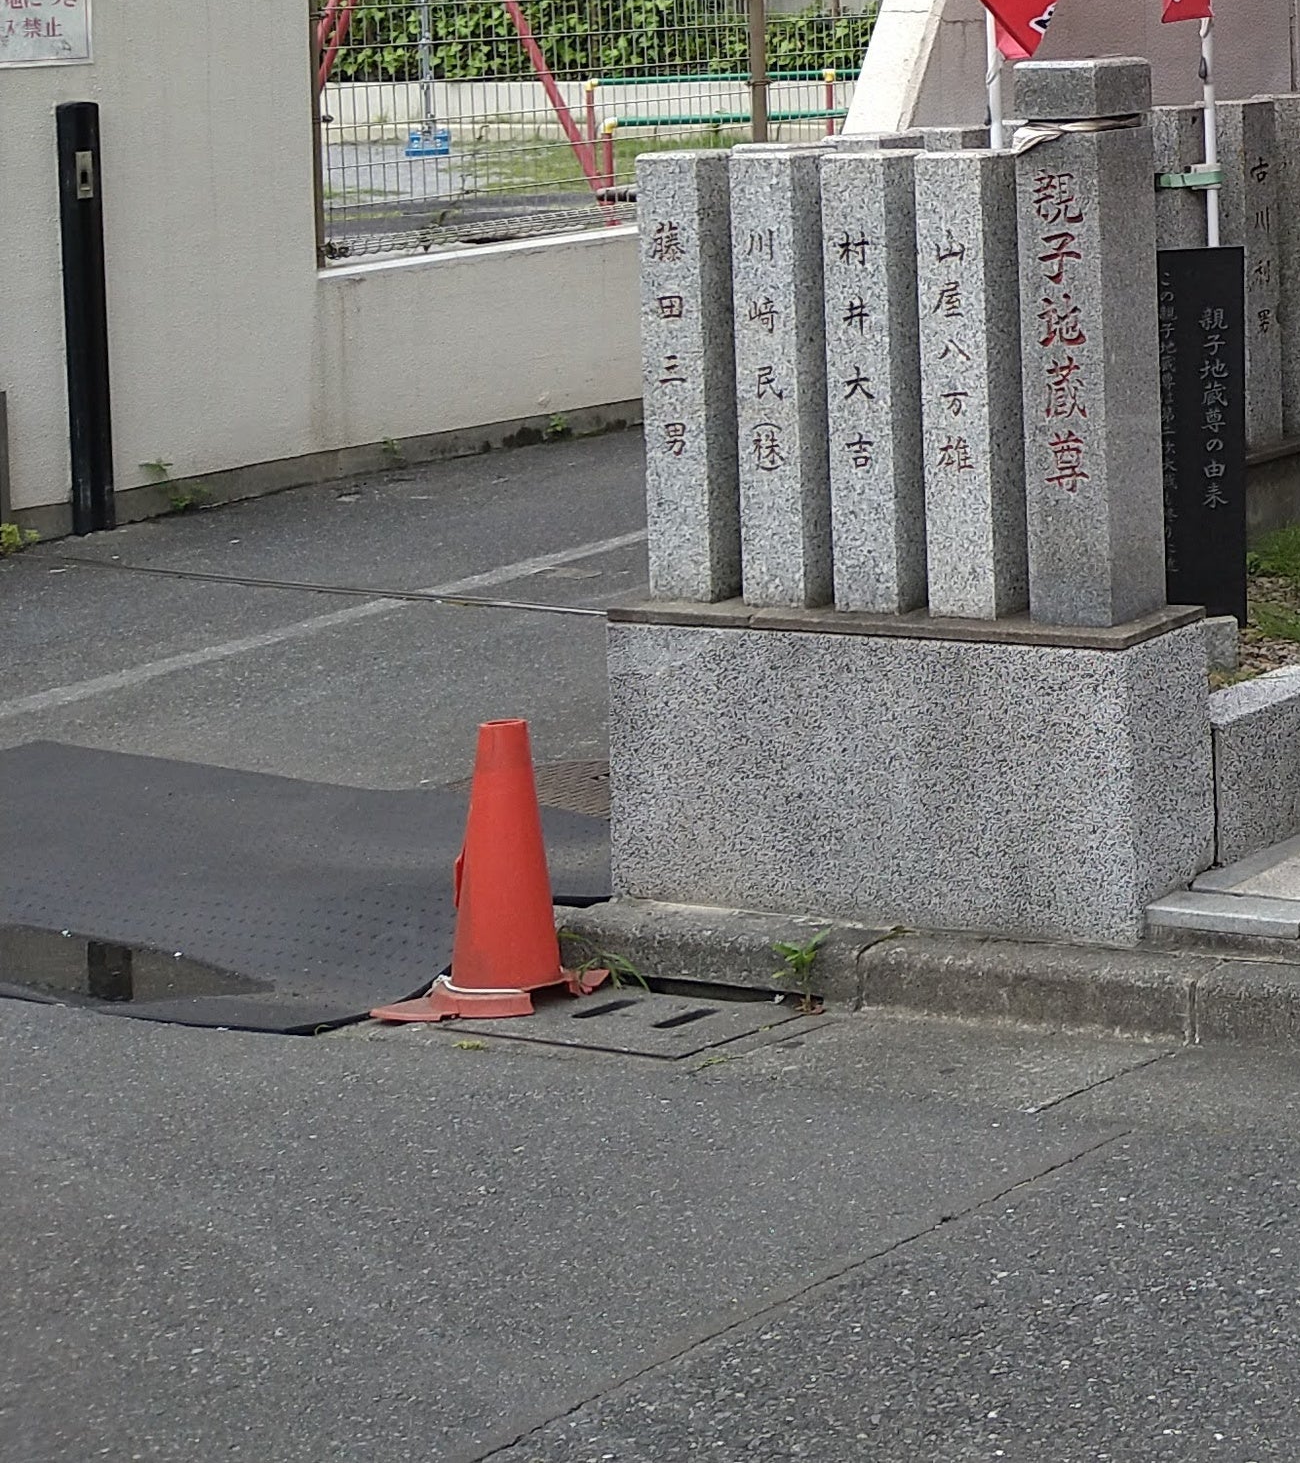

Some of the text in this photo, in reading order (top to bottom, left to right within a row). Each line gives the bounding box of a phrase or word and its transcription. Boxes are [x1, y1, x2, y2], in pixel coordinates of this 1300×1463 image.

[0, 15, 64, 39] 入禁止
[652, 222, 688, 459] 藤田三男
[837, 231, 877, 472] 村井大吉
[1197, 306, 1231, 510] 親子地蔵尊の由来
